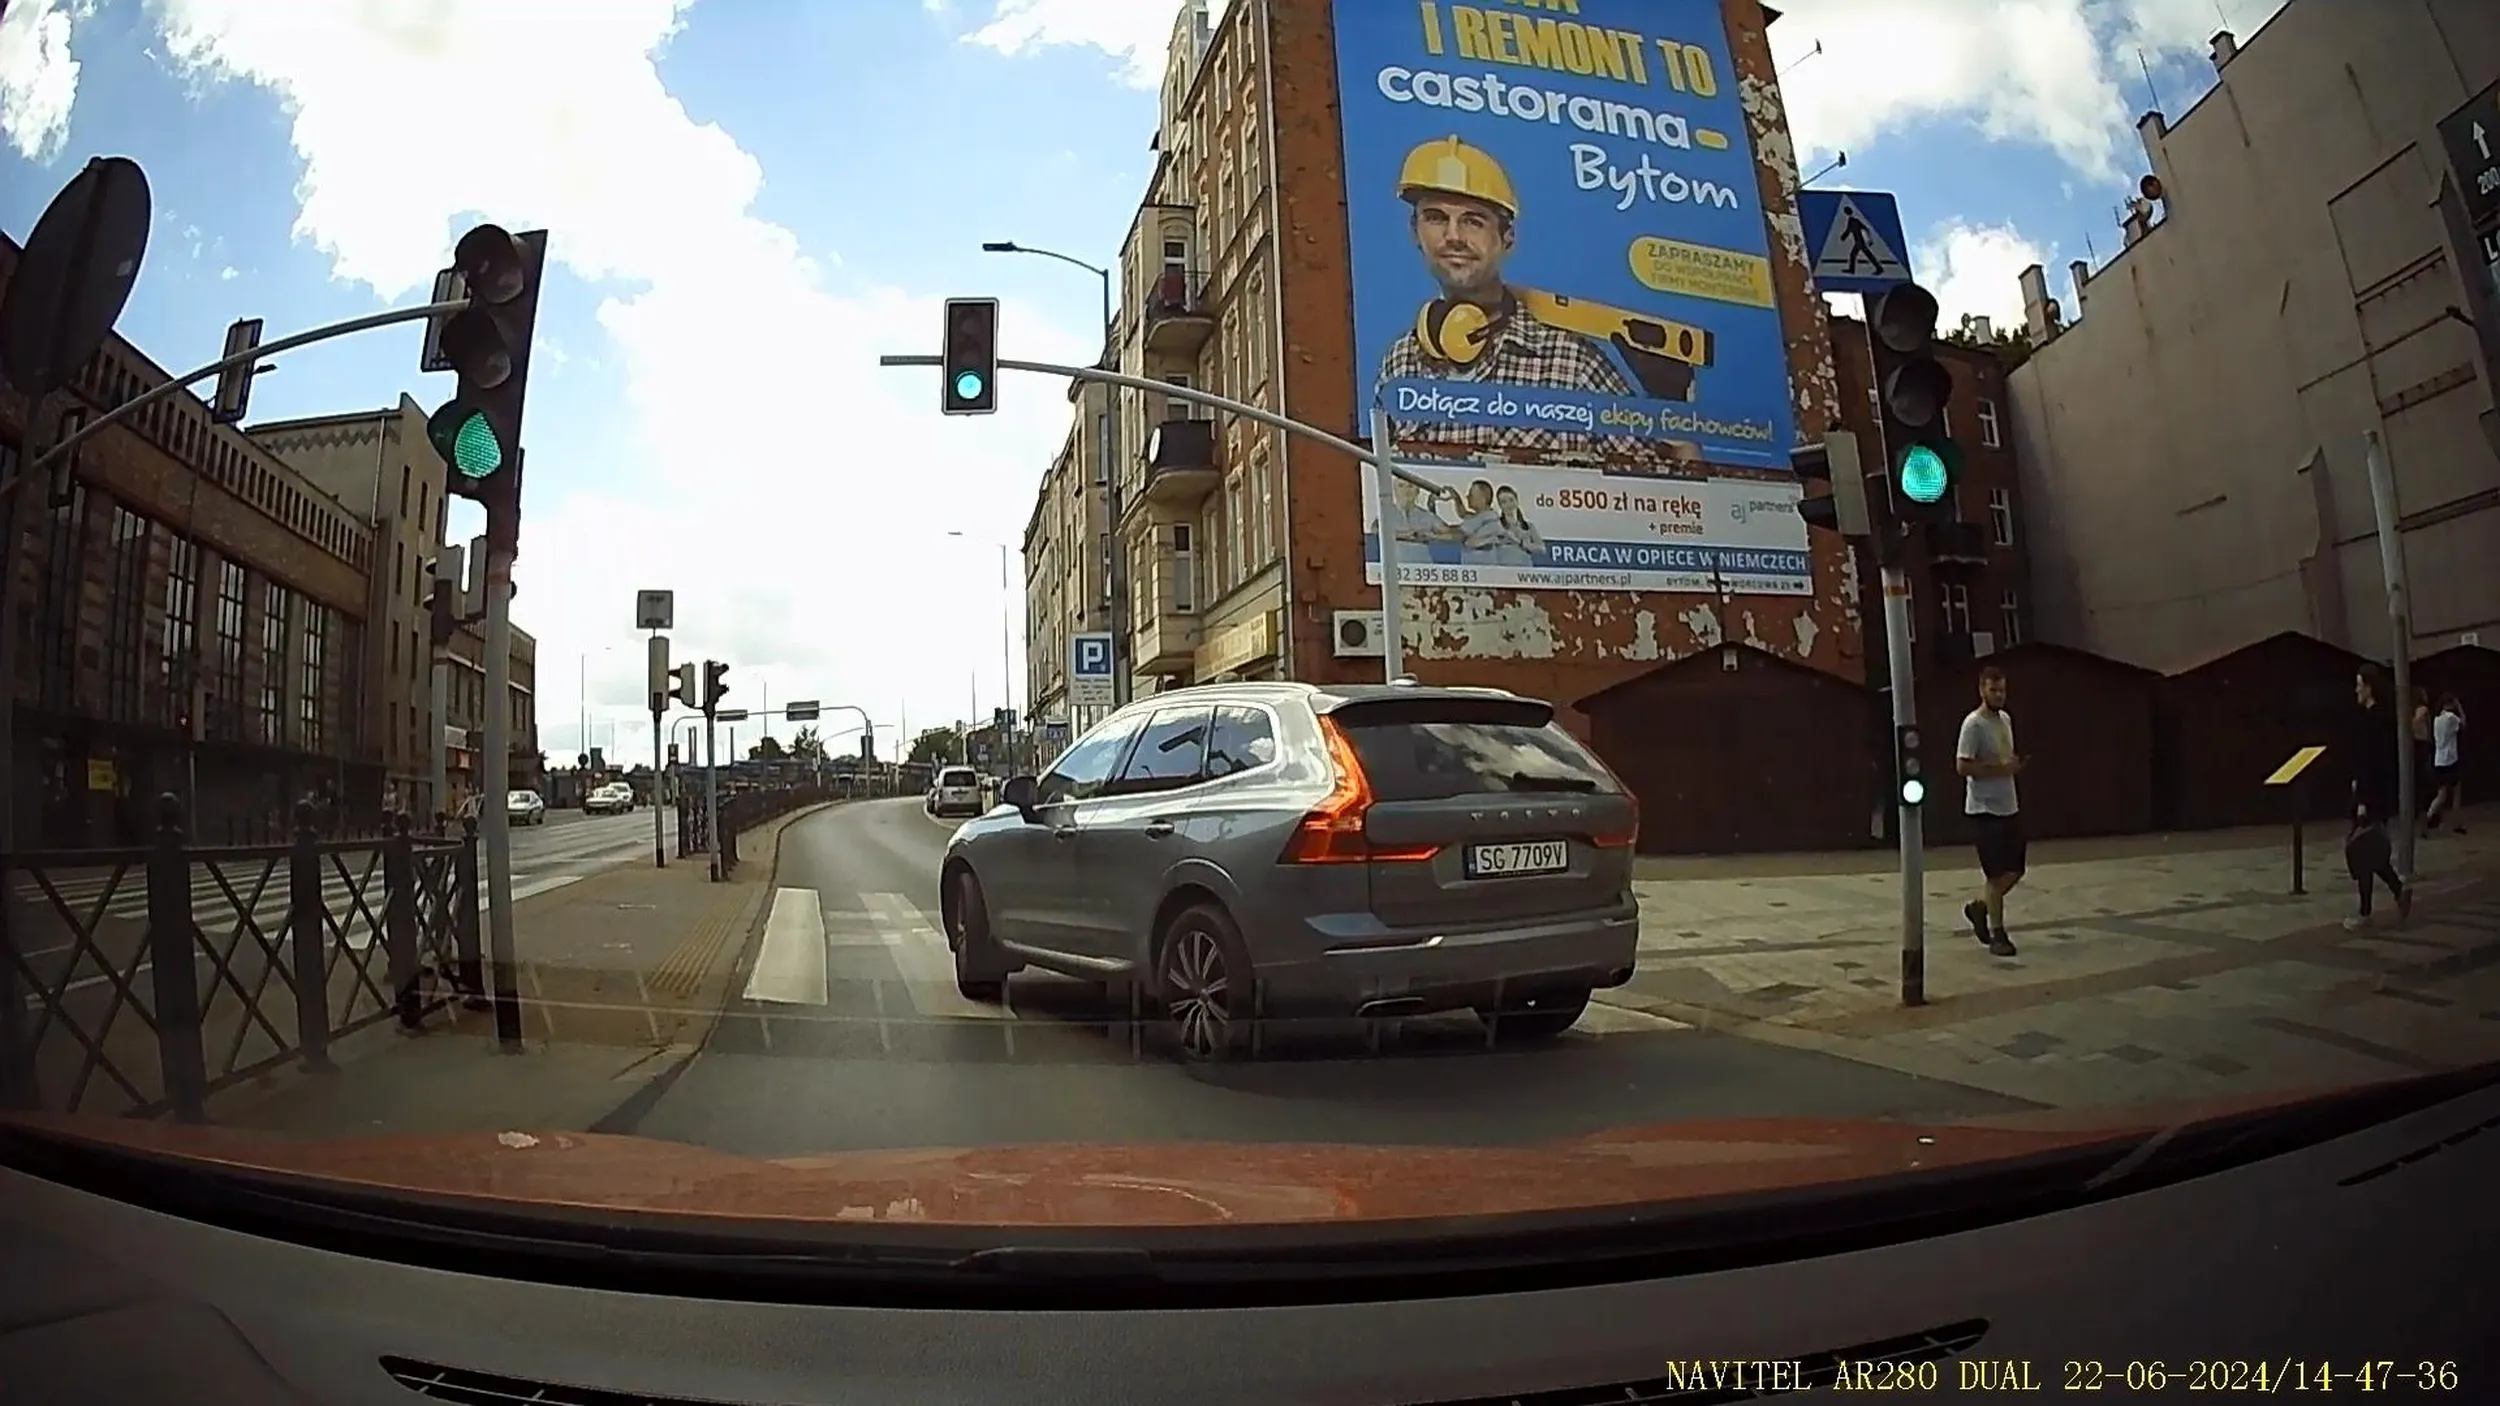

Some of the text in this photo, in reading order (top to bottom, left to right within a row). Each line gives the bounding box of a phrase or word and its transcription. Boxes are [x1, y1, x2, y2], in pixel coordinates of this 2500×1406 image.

[1420, 2, 1717, 97] I REMONT TO
[1377, 66, 1690, 149] castorama
[1569, 143, 1738, 210] Bytom
[1646, 243, 1754, 273] ZAPRASZAMY
[1398, 387, 1773, 441] Dołącz do naszej ekipy fachowców!
[1536, 490, 1701, 519] do 8500 zł na rękę
[1660, 520, 1703, 536] premie
[1552, 546, 1806, 570] PRACA W OPIECE W NIEMCZECH
[1415, 568, 1438, 581] 395
[1442, 569, 1458, 582] 88
[1462, 570, 1477, 582] 83
[1518, 571, 1631, 586] www.ajpartners.pl
[1083, 642, 1103, 671] P
[1480, 847, 1505, 870] SG
[1511, 844, 1562, 868] 7709V
